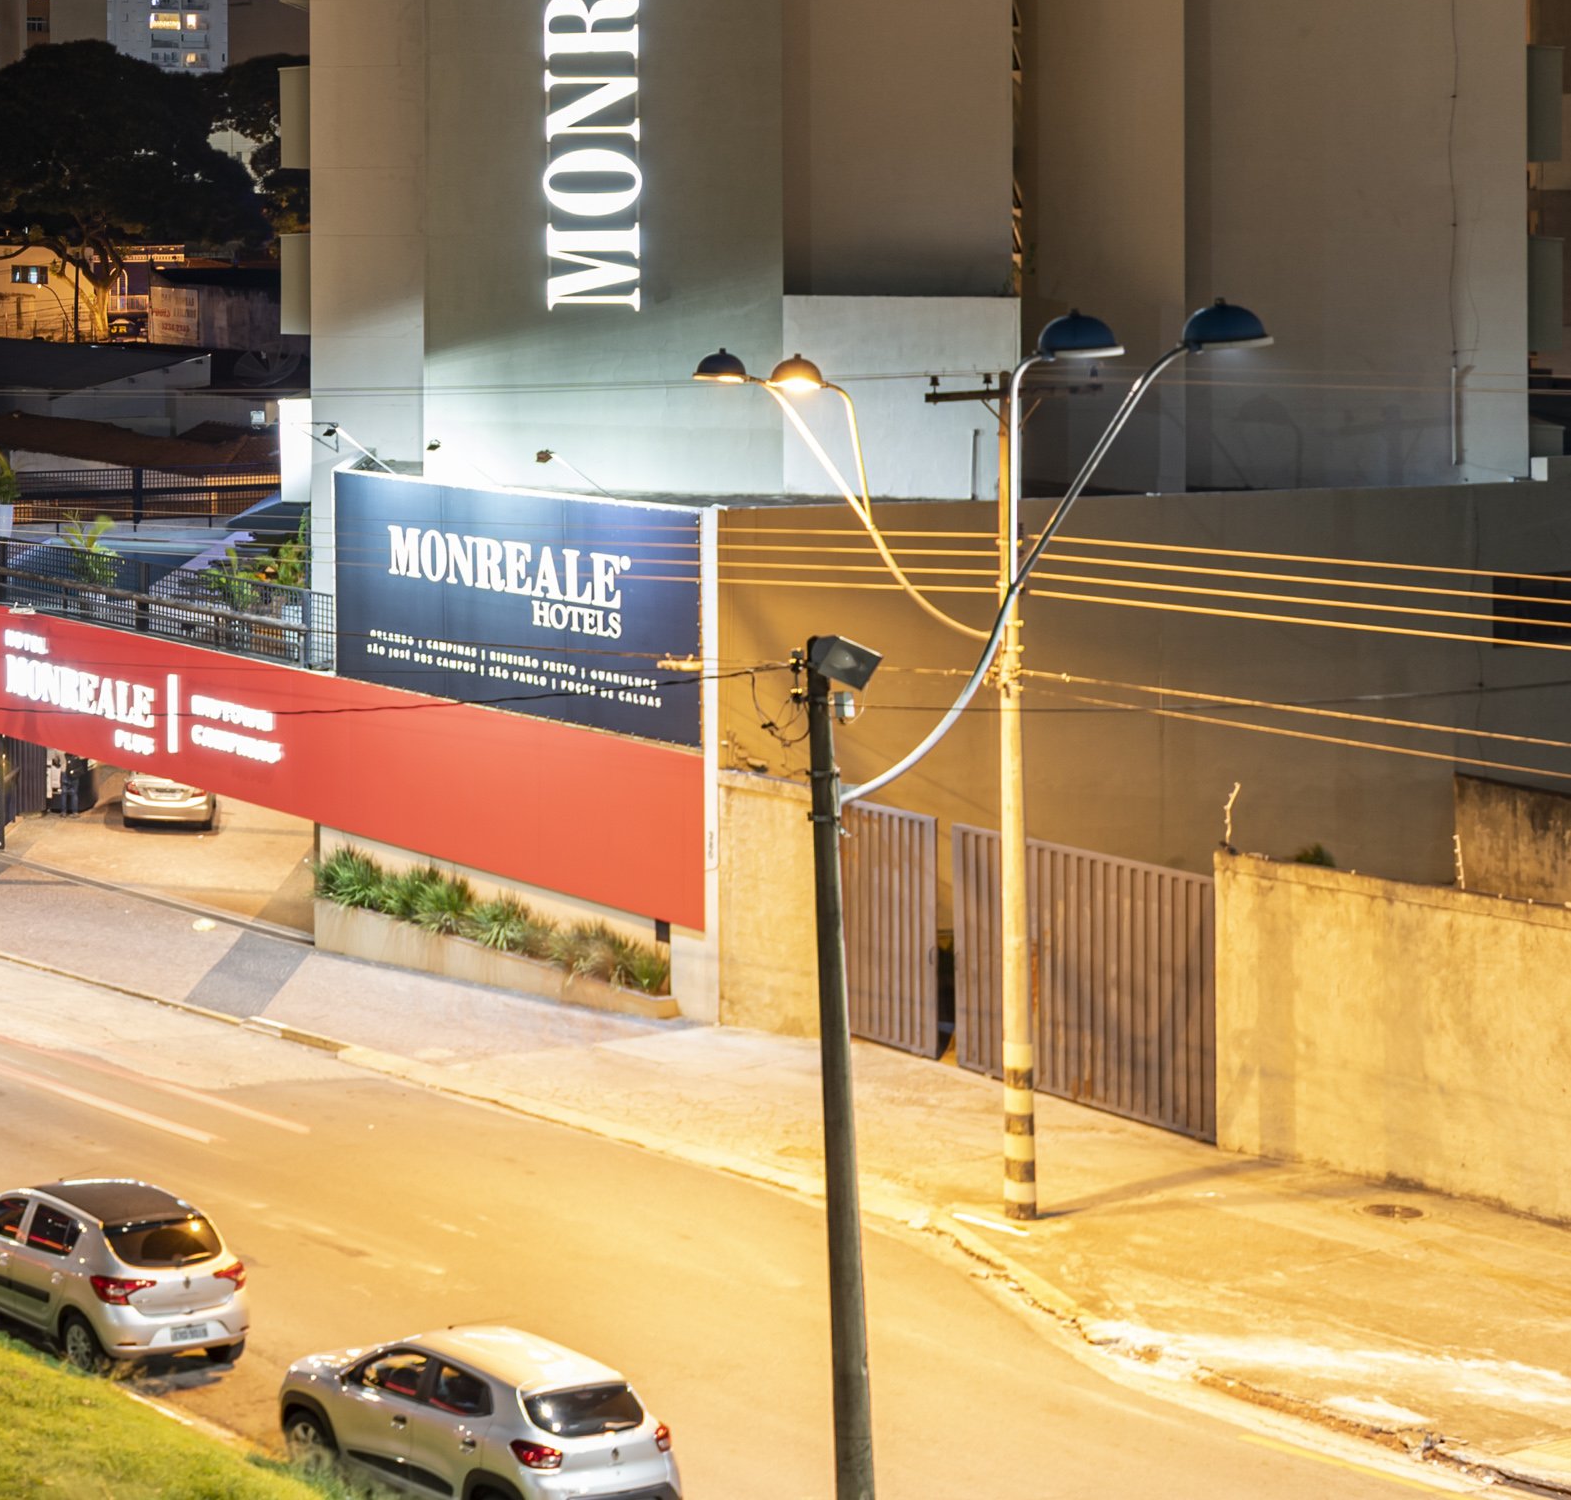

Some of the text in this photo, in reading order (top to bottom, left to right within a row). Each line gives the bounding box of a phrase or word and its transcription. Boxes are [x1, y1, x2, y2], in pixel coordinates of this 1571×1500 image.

[387, 525, 622, 609] MONREALE
[531, 599, 623, 639] HOTELS
[5, 654, 155, 728] MONREALE
[366, 642, 662, 708] SÃO JOSÉ DOS CAMPOS SÃO PAULO POÇOS DE CALDAS
[369, 629, 658, 691] ORLANDO CAMPINAS RIBEIRÃO PRETO GUARULHOS
